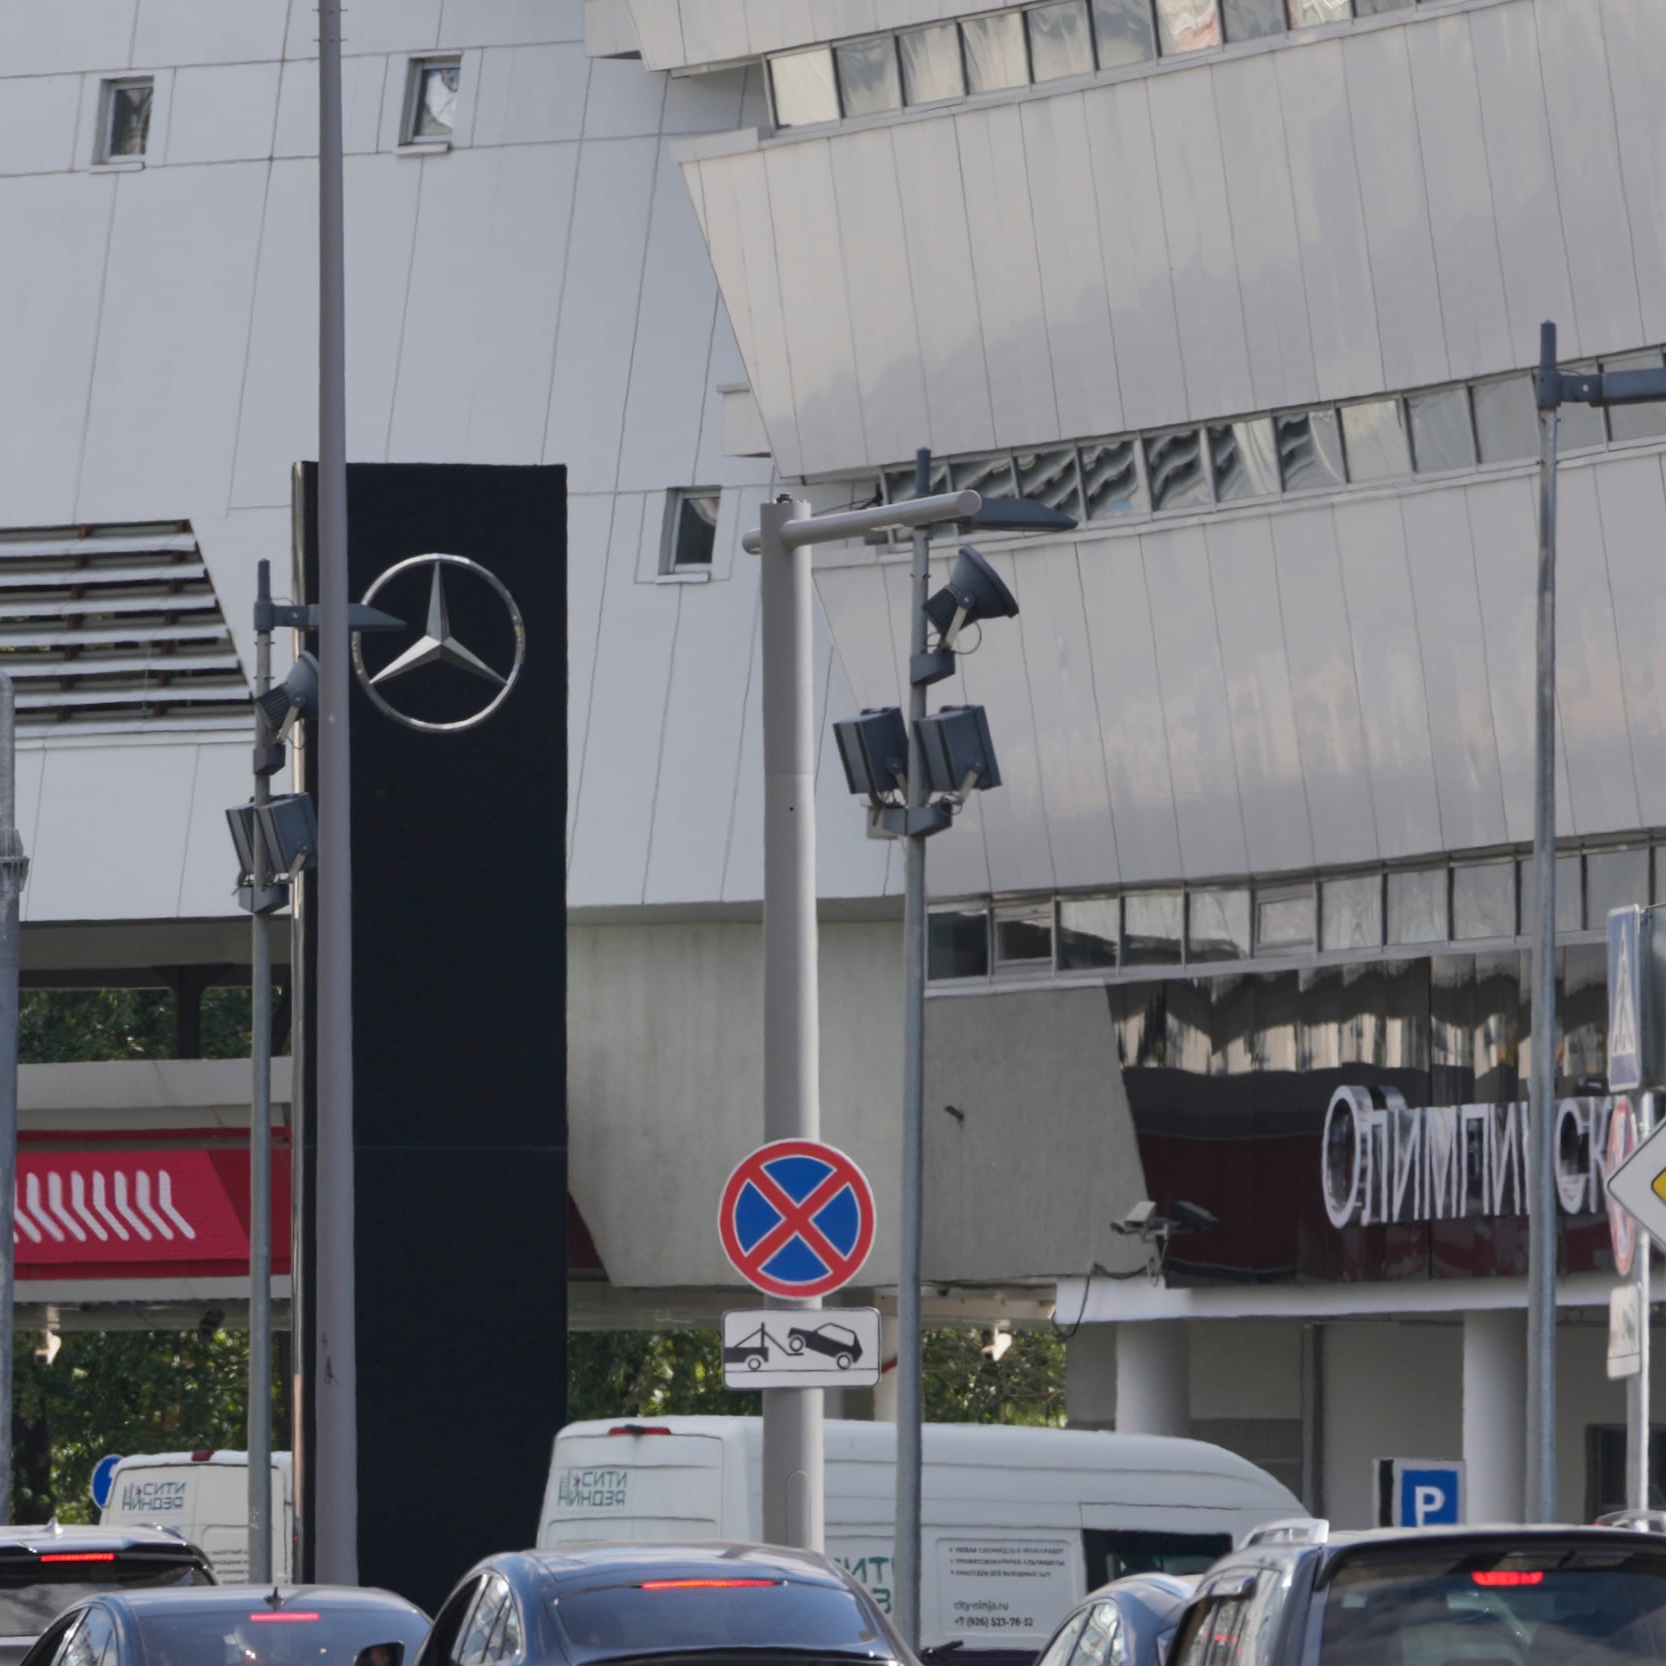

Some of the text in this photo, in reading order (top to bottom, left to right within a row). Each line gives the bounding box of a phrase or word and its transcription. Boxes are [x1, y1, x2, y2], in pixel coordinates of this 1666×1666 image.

[582, 1471, 628, 1488] СИТИ
[142, 1482, 187, 1496] СИТИ
[1414, 1485, 1446, 1527] P
